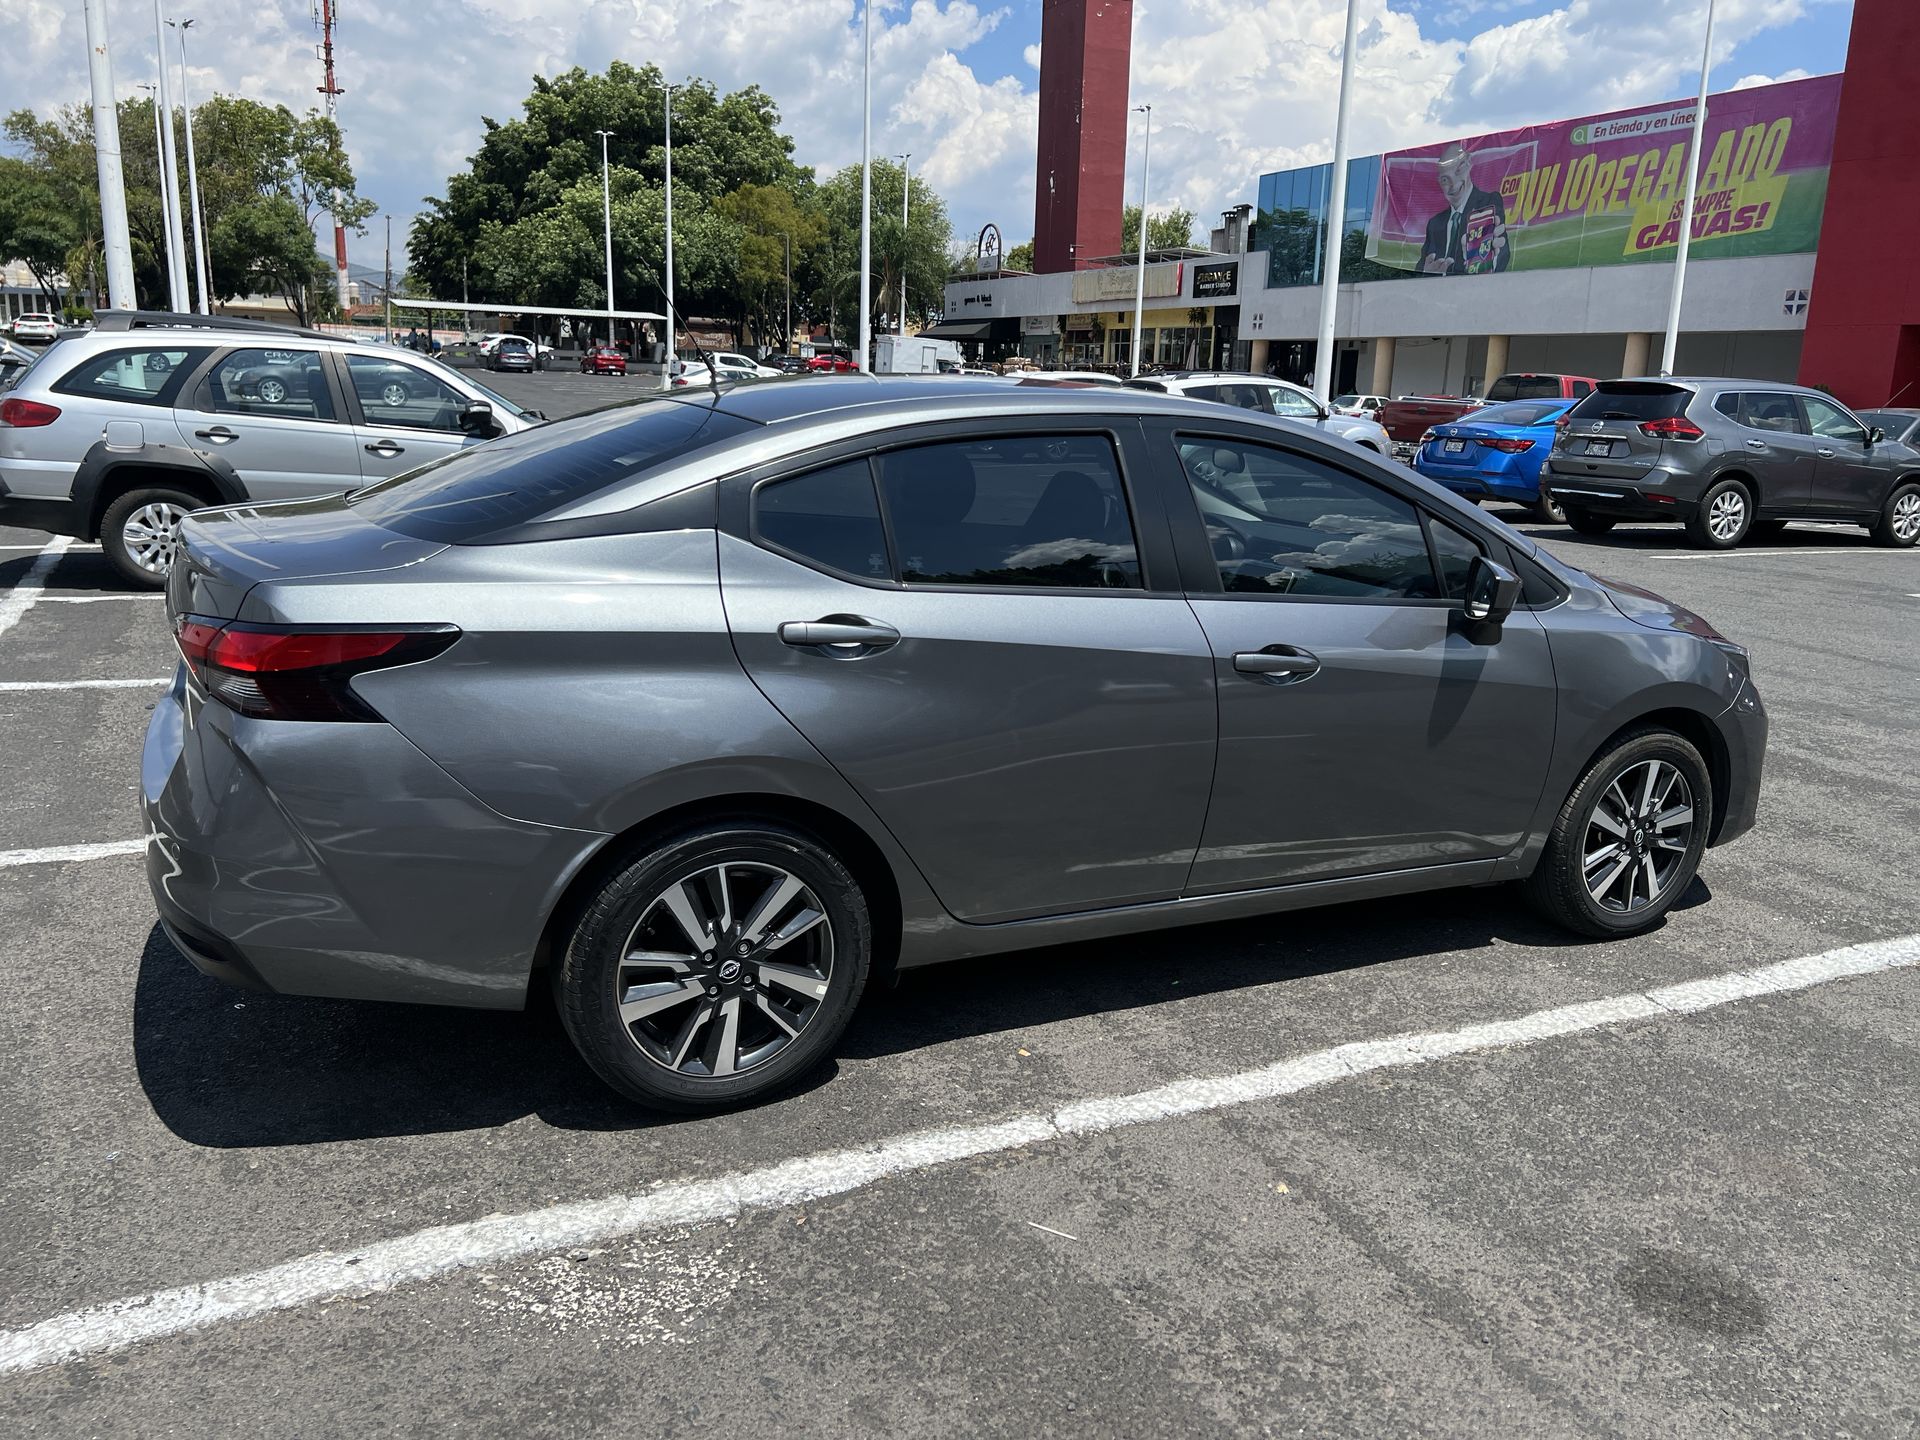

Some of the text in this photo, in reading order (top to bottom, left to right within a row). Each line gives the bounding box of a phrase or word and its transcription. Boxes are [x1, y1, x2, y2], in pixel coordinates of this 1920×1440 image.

[1593, 126, 1606, 139] En
[1608, 119, 1642, 136] tienda
[1643, 120, 1652, 134] y
[1654, 118, 1668, 129] en
[1668, 188, 1736, 220] ¡SMPRE
[1635, 201, 1770, 249] GANAS!
